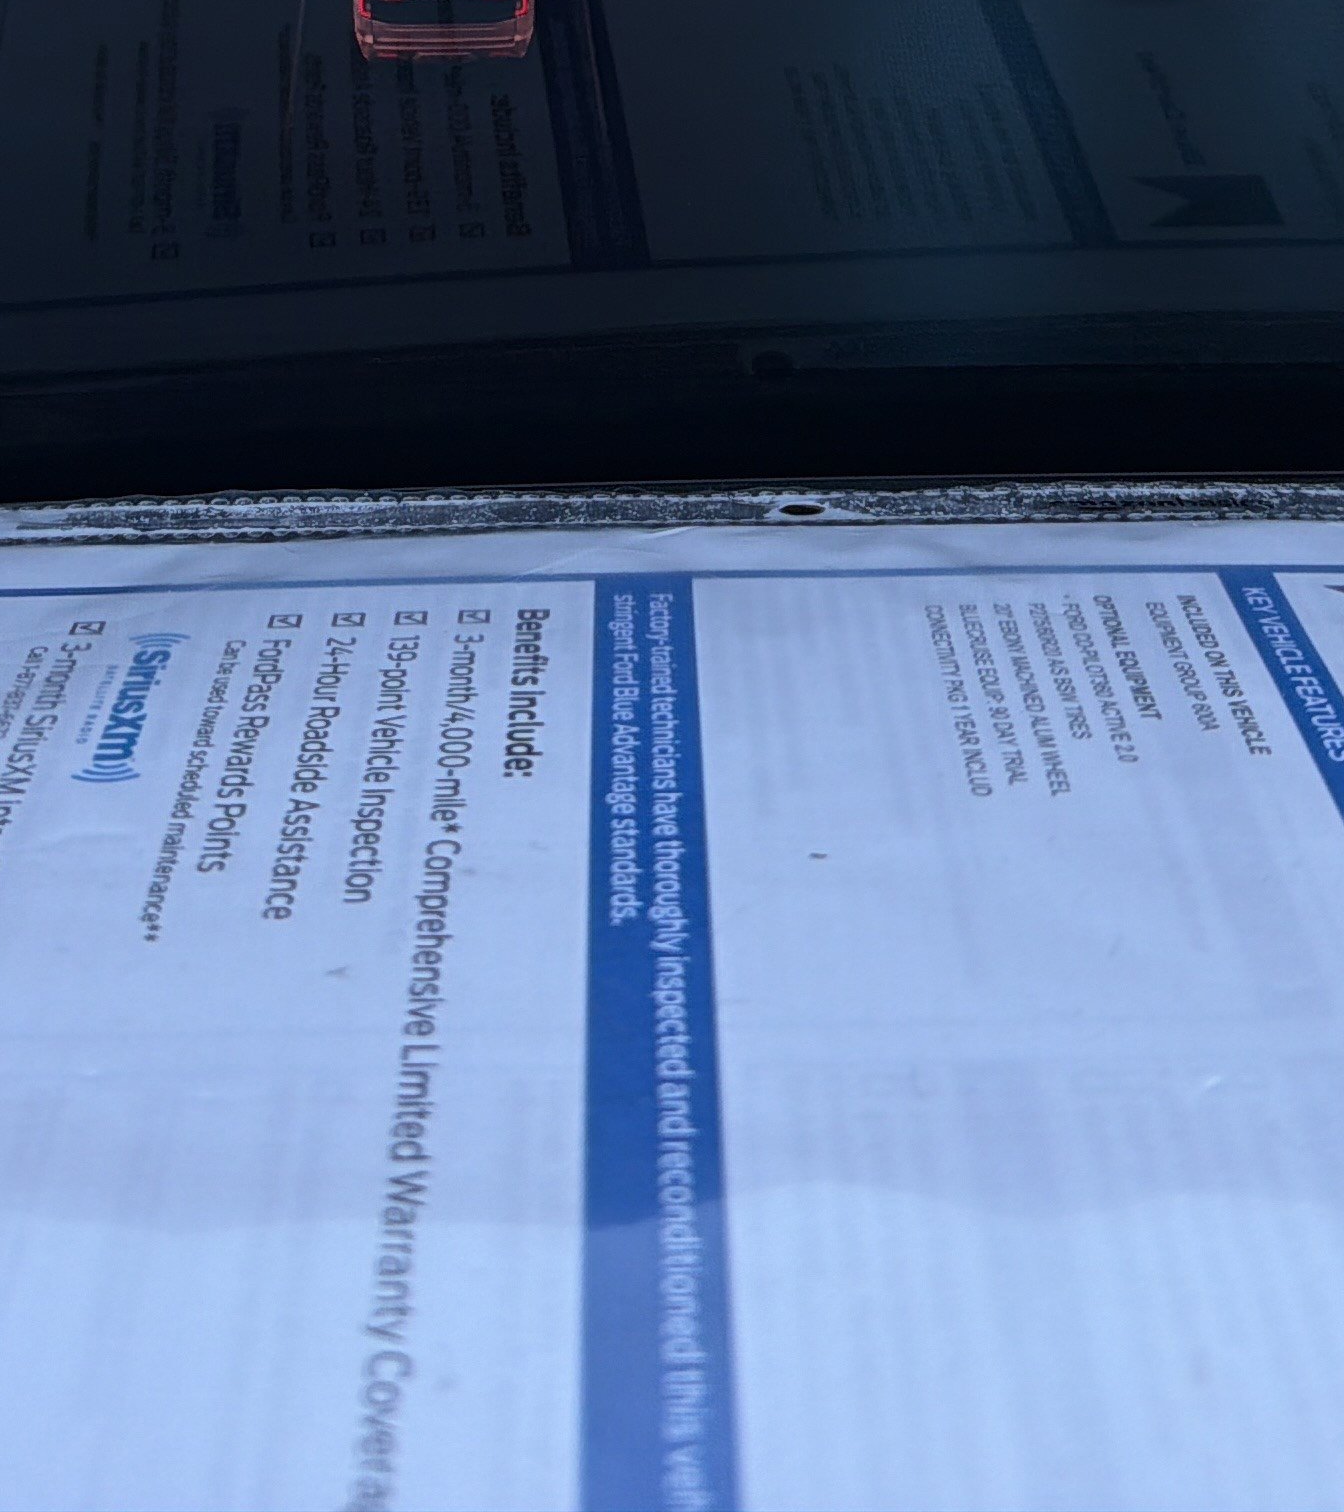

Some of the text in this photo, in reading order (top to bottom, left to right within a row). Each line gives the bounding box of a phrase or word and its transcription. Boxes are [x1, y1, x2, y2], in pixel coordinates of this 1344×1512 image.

[1062, 602, 1088, 632] FORD
[1241, 586, 1278, 614] KEY
[24, 645, 49, 664] Call
[33, 642, 92, 711] 3-month
[215, 661, 240, 675] be
[221, 639, 247, 661] Can
[510, 608, 551, 686] Benefits
[646, 593, 677, 695] Factory-trained
[924, 604, 961, 677] CONNECTIVITY
[1092, 595, 1162, 719] OPTIONAL EQUIPMENT
[1145, 601, 1189, 659] EQUIPMENT
[1172, 661, 1208, 701] GROUP
[1176, 594, 1272, 755] INCLUDED ON THIS VEHICLE
[1258, 616, 1312, 674] VEHICLE
[192, 705, 224, 748] toward
[206, 676, 231, 704] used
[944, 679, 968, 703] PKG
[958, 603, 1028, 786] BLUECRUISE 90 DAY TRIAL
[997, 619, 1071, 797] EBONY MACHINED ALUM WHEEL
[1047, 658, 1093, 740] A/S BSW TIRES
[1099, 700, 1132, 742] ACTIVE
[196, 638, 292, 873] FordPass Rewards Points
[606, 594, 641, 925] stringent Ford Blue Advantage standards.
[650, 696, 681, 790] technicians
[953, 713, 980, 746] YEAR
[1113, 744, 1140, 763] 2.0
[170, 750, 209, 819] scheduled
[262, 636, 357, 920] 24-Hour Roadside Assistance
[343, 635, 420, 904] 139-point Vehicle Inspection
[961, 748, 993, 797] INCLUD
[652, 792, 683, 836] have
[649, 840, 688, 952] thoroughly
[403, 839, 461, 1036] Comprehensive
[653, 956, 693, 1078] inspected
[389, 1044, 440, 1163] Limited
[657, 1082, 696, 1136] and
[368, 1170, 429, 1340] Warranty
[658, 1142, 705, 1363] reconditioned
